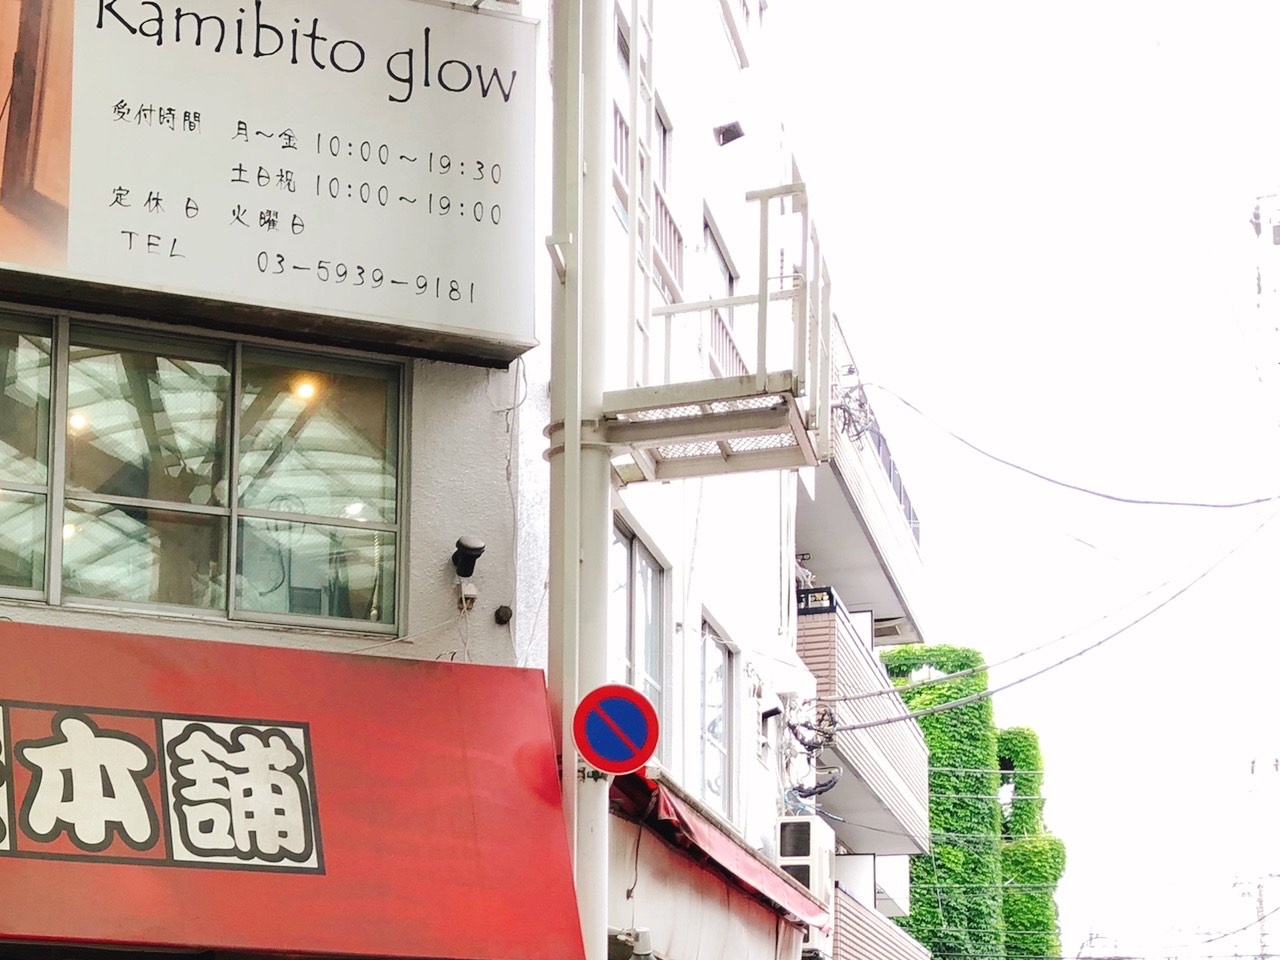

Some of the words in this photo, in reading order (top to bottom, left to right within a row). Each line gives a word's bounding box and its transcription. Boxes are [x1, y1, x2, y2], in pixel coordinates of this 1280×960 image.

[95, 0, 366, 74] Kamibito
[385, 26, 517, 103] glow
[111, 98, 202, 132] 受付時間
[230, 162, 297, 194] 土日祝
[109, 185, 200, 220] 定休日
[230, 203, 306, 236] 火曜日
[120, 229, 187, 260] TEL
